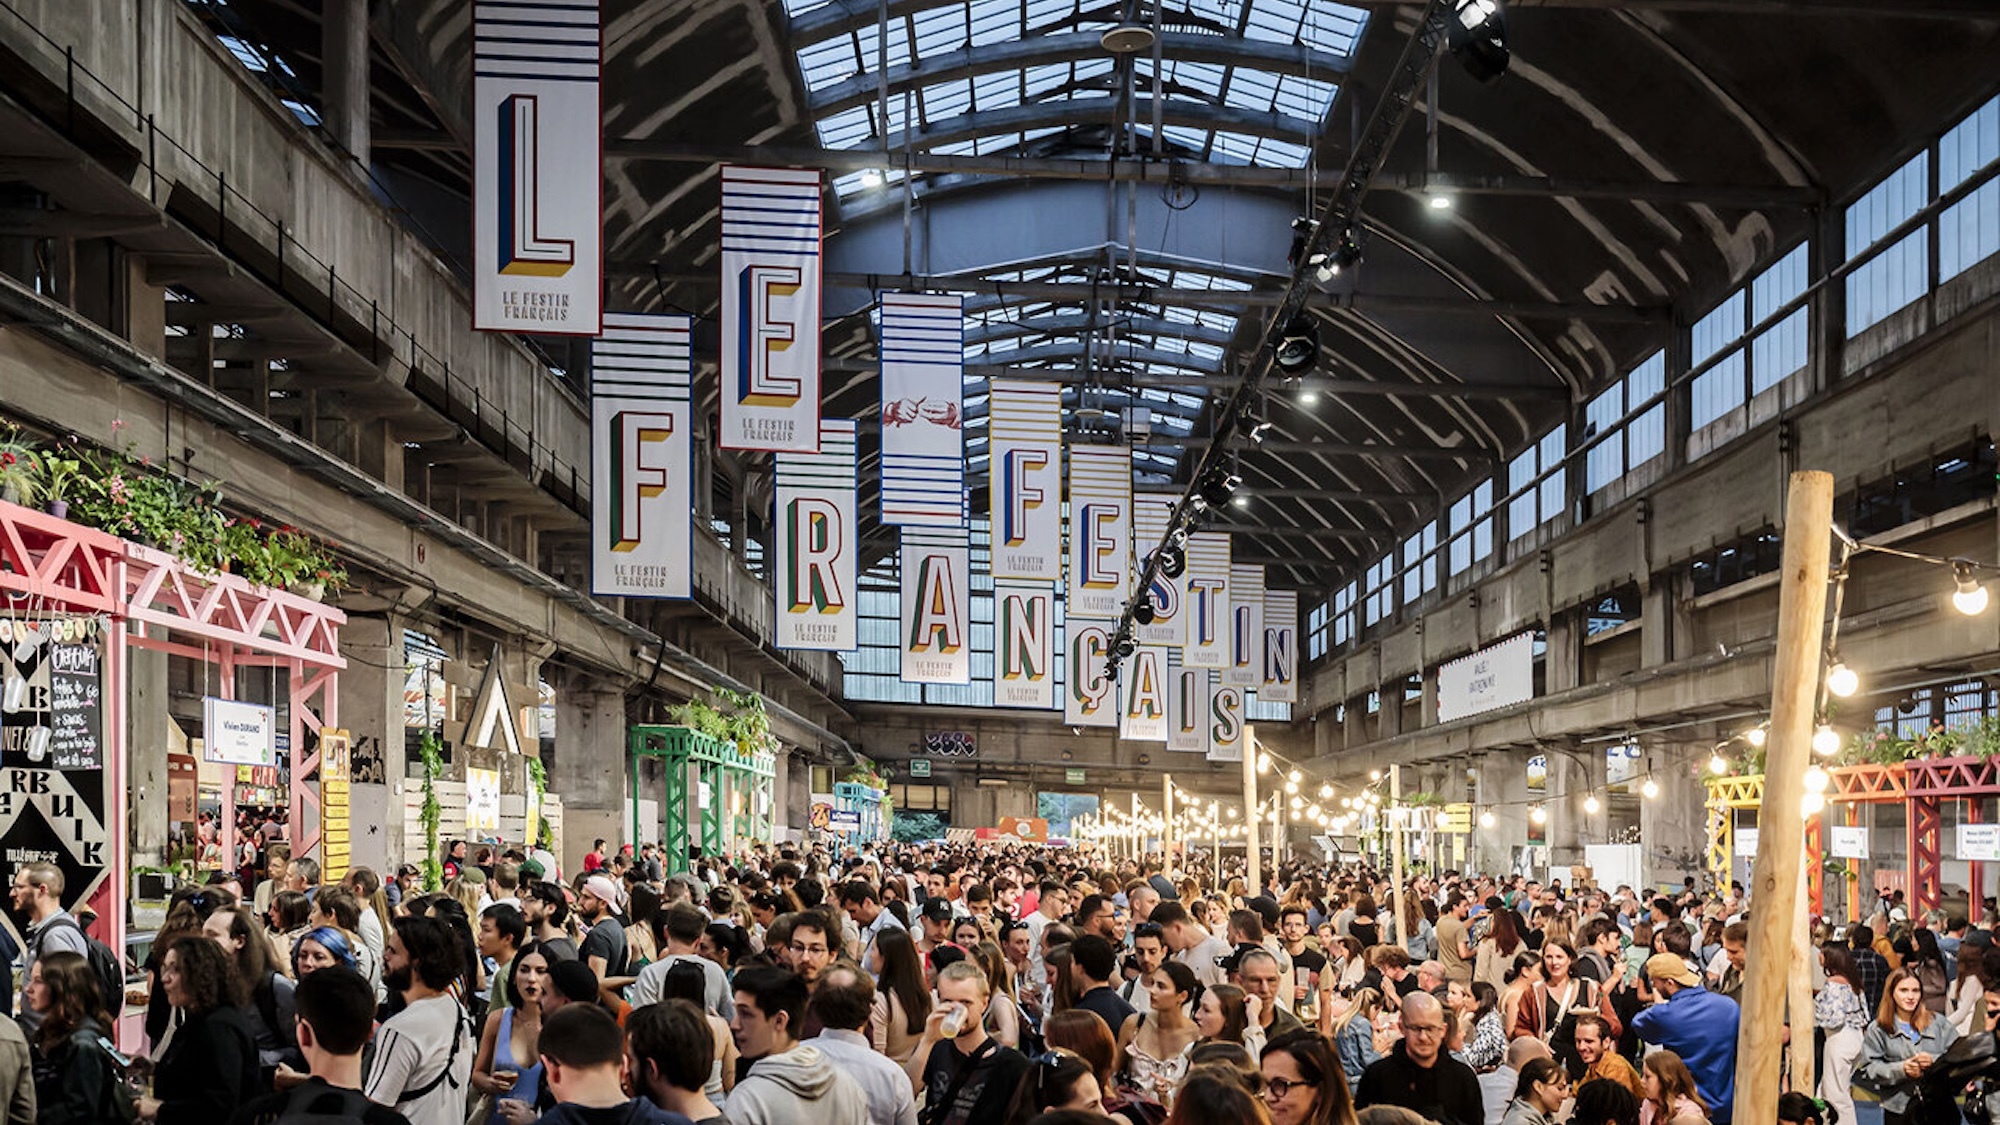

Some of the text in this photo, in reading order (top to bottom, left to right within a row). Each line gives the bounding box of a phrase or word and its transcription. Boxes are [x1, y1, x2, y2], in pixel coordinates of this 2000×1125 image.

[498, 94, 574, 277] L
[502, 291, 569, 307] LE FESTIN
[504, 306, 567, 322] FRANÇAIS
[739, 265, 801, 408] E
[610, 410, 673, 552] F
[1004, 449, 1048, 547] F
[787, 497, 844, 614] R
[1081, 504, 1119, 589] E
[910, 555, 960, 654] A
[1003, 595, 1045, 681] N
[1188, 579, 1226, 646] T
[1236, 606, 1250, 667] I
[1073, 627, 1109, 715] Ç
[1127, 652, 1162, 719] A
[1264, 628, 1291, 684] N
[1181, 672, 1194, 732] I
[1213, 688, 1240, 745] S
